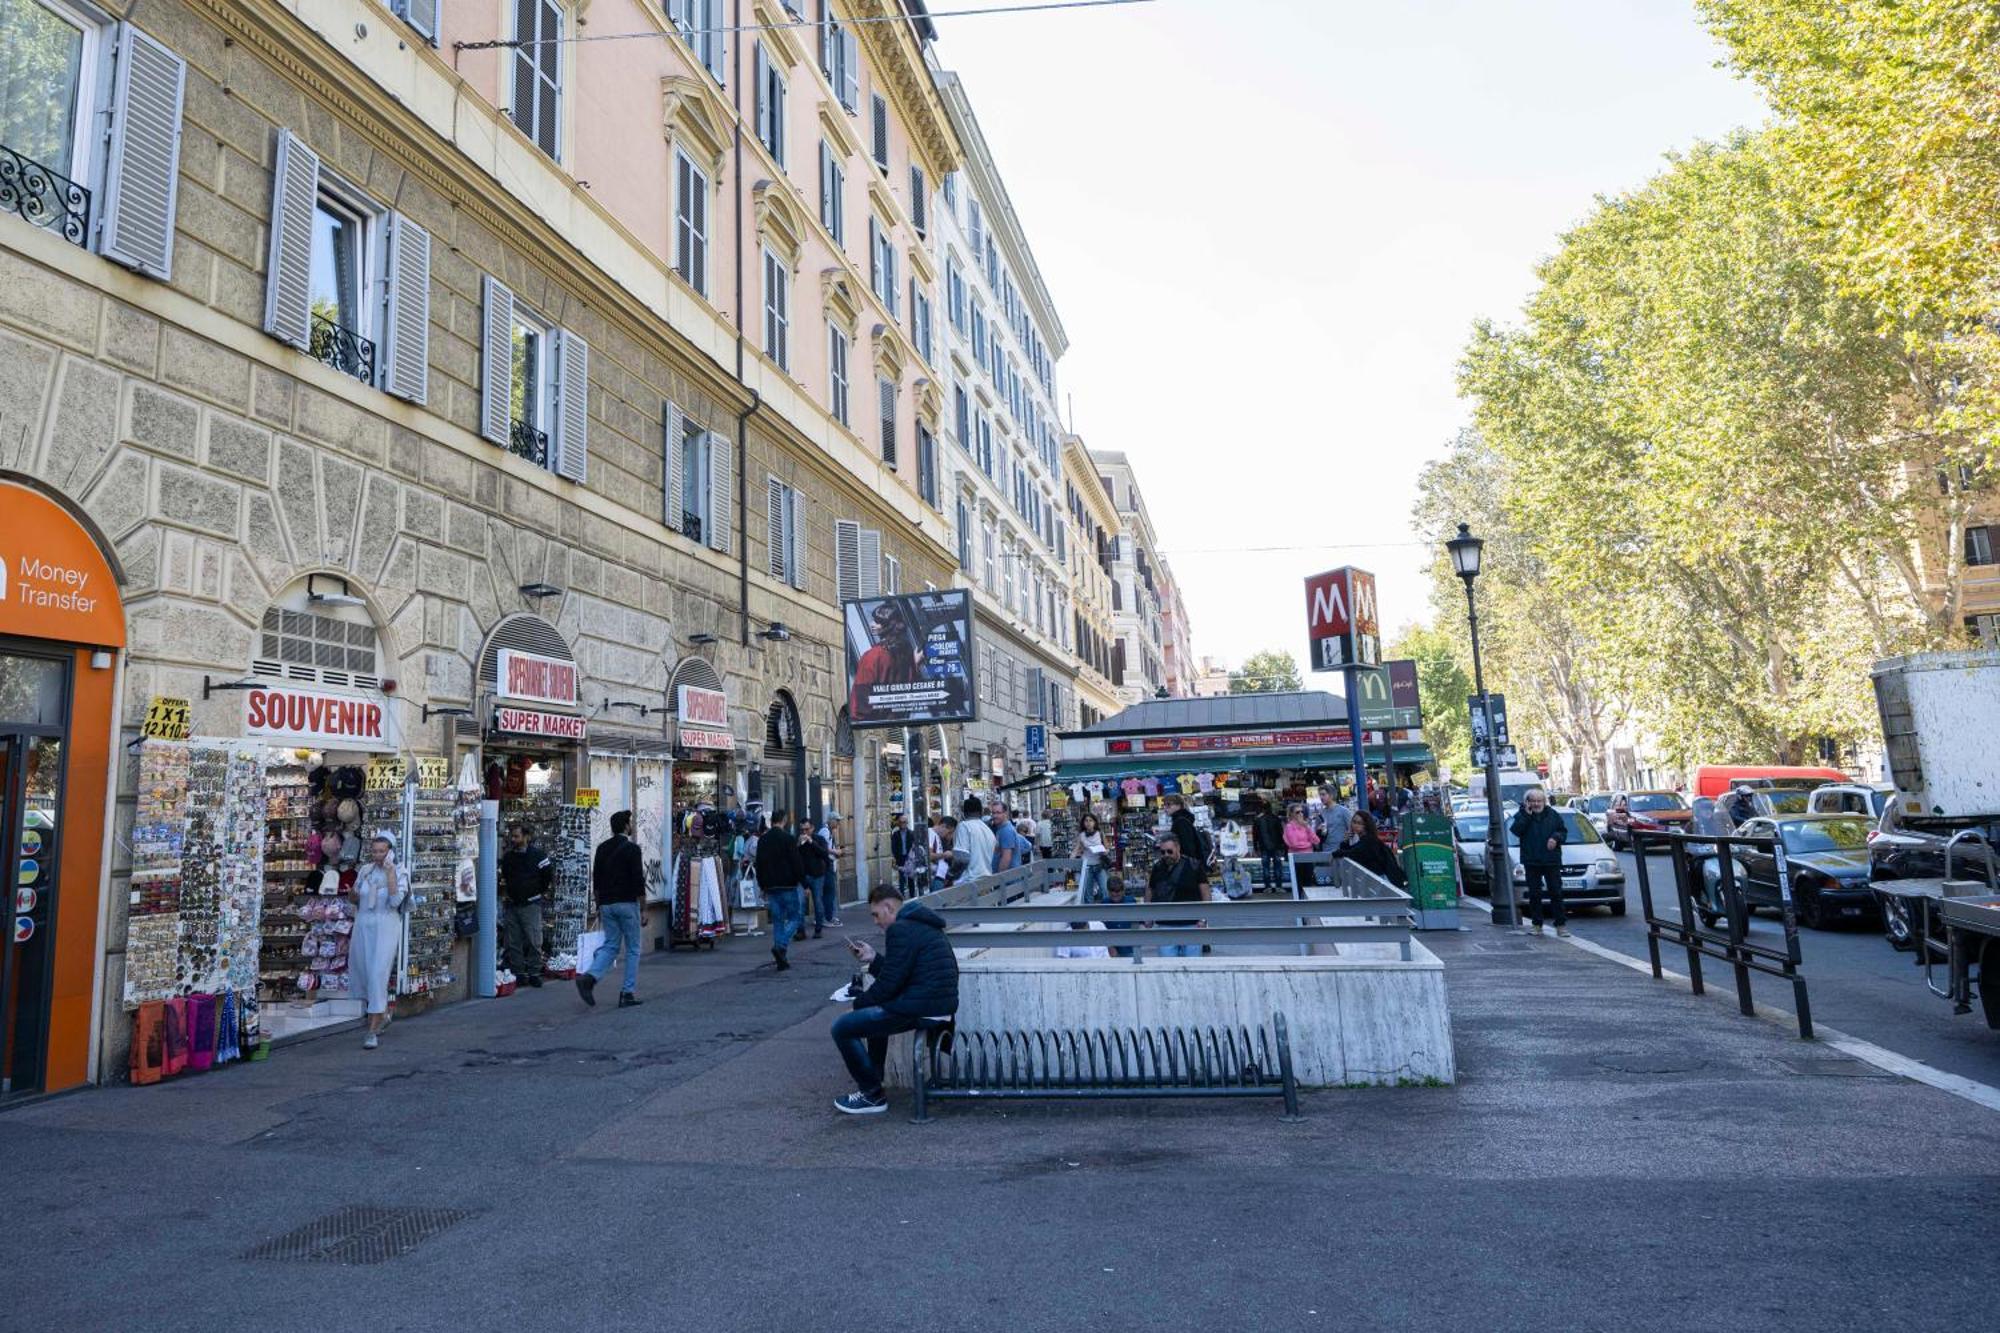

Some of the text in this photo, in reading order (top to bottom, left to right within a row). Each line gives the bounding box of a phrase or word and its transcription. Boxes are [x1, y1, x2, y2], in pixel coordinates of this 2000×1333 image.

[20, 556, 88, 591] Money
[18, 582, 96, 612] Transfer
[1312, 583, 1348, 627] M
[1356, 581, 1376, 625] M
[150, 706, 159, 719] 1
[248, 690, 382, 738] SOUVENIR
[502, 710, 586, 737] SUPER MARKET
[145, 721, 158, 735] 12
[683, 732, 706, 747] SUPER
